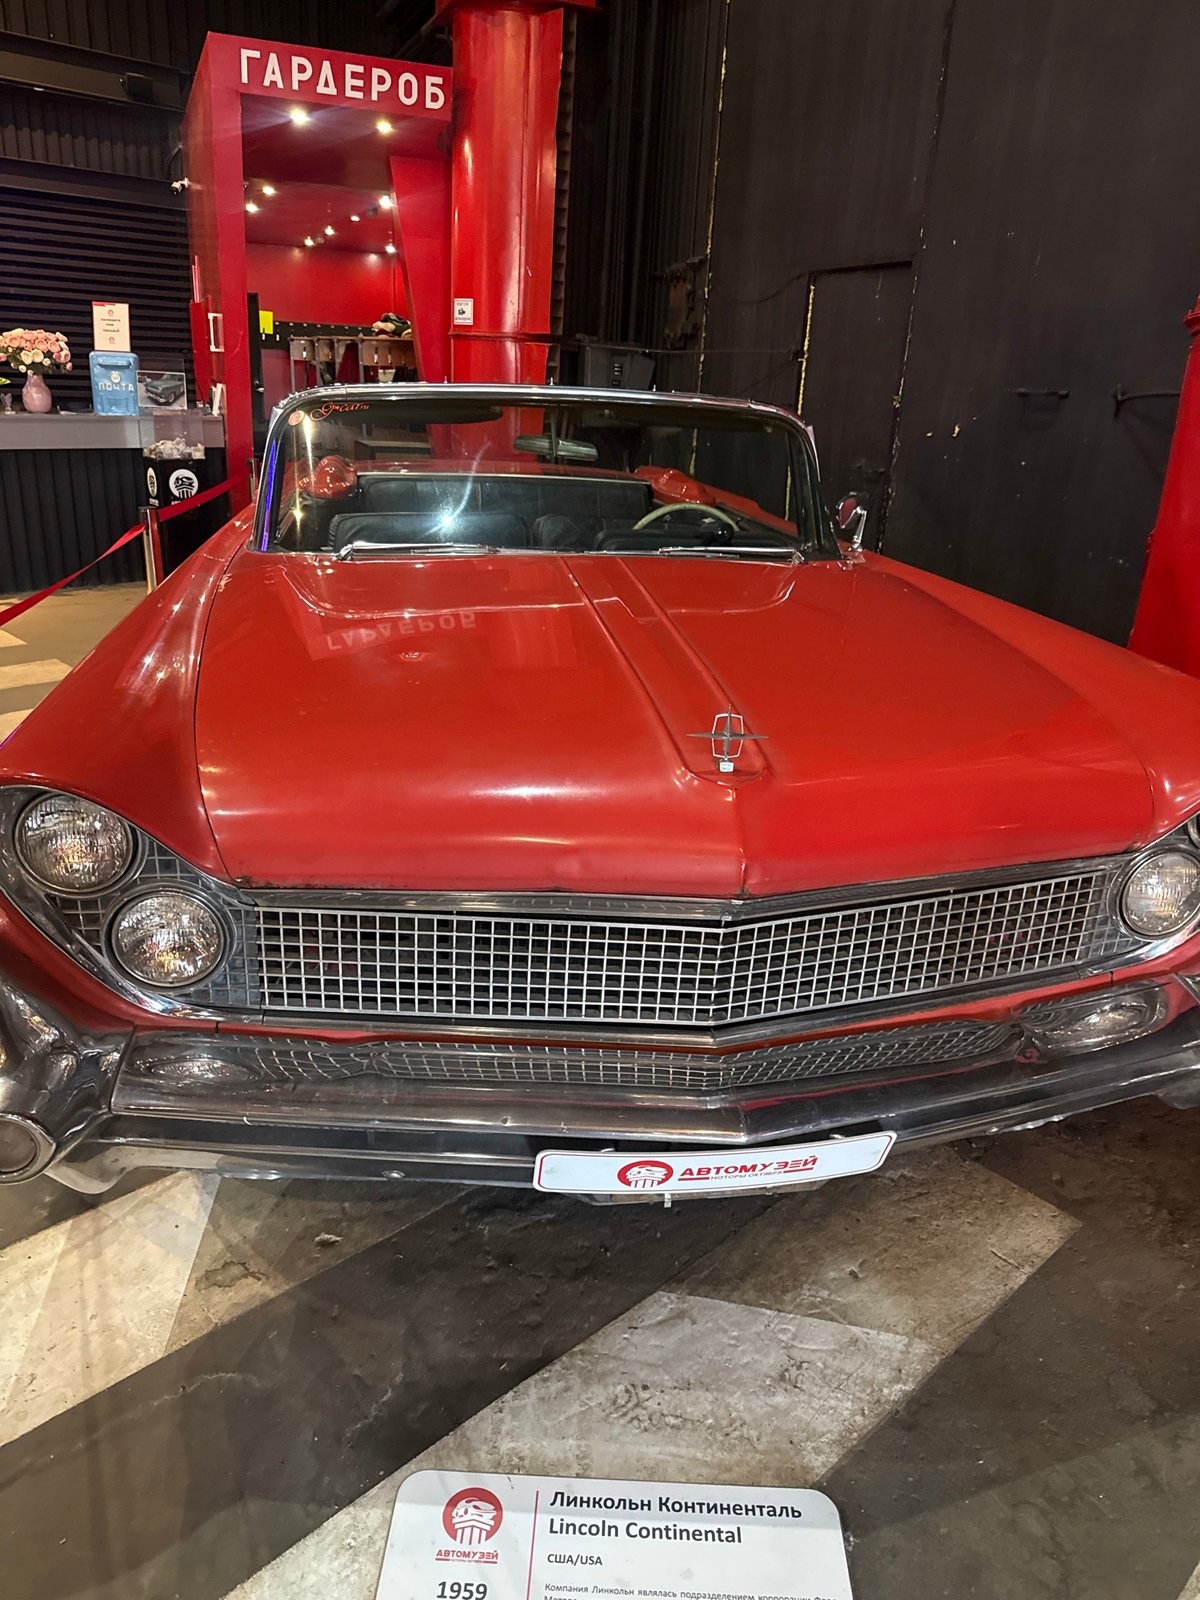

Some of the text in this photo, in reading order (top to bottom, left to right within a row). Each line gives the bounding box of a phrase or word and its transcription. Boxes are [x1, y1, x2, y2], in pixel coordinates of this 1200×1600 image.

[240, 48, 445, 110] ГАРДЕРОБ
[98, 382, 135, 392] ПОЧТА
[680, 1155, 818, 1177] АВТОМУЗЕЙ
[550, 1491, 802, 1519] Линкольн Континенталь
[549, 1518, 742, 1543] Lincoln Continental
[436, 1549, 499, 1560] АВТОМУЗЕЙ
[547, 1553, 603, 1566] США/USA
[436, 1581, 488, 1600] 1959
[544, 1583, 589, 1593] Компания
[591, 1585, 635, 1596] Линкольн
[637, 1589, 678, 1598] являлась
[680, 1591, 755, 1600] подразделением
